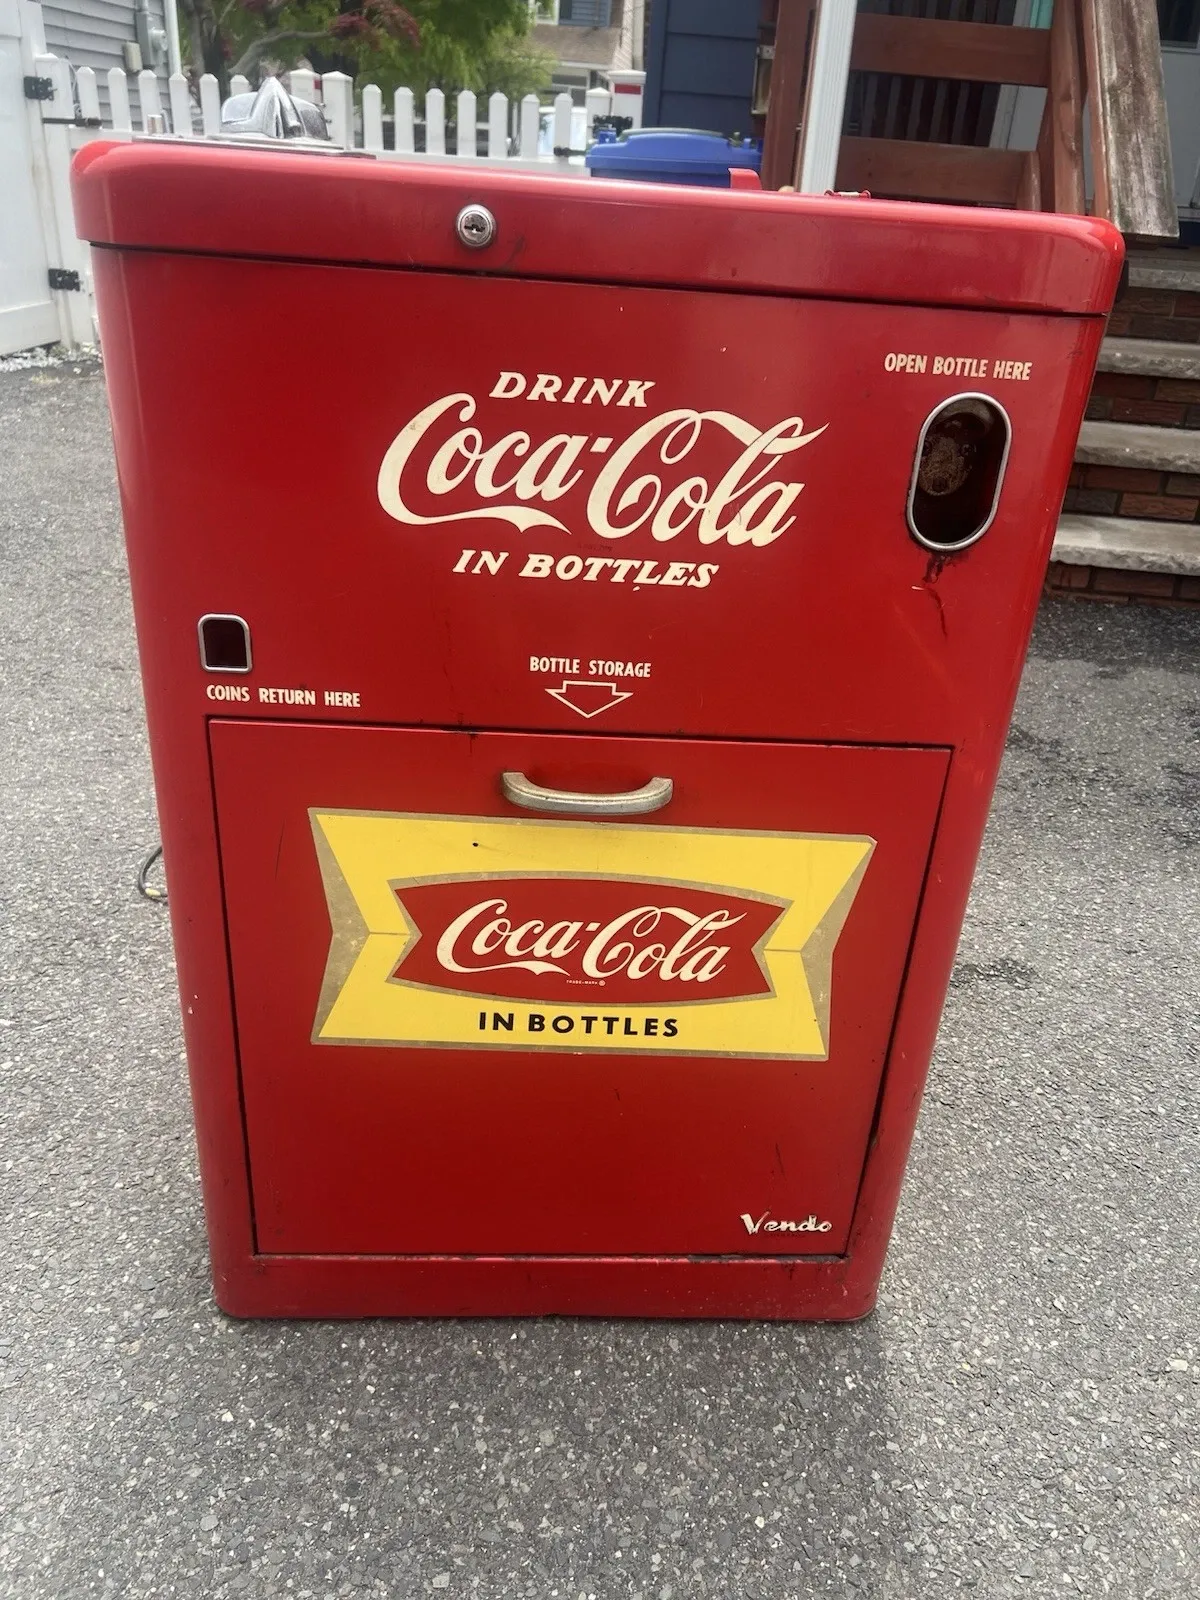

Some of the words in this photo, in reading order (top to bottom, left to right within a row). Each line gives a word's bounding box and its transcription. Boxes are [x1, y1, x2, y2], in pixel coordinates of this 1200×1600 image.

[884, 353, 927, 373] OPEN
[932, 356, 988, 378] BOTTLE
[993, 360, 1032, 380] HERE
[489, 371, 655, 408] DRINK
[377, 393, 830, 547] Coca-Cola
[453, 549, 510, 576] IN
[518, 554, 719, 589] BOTTLES
[529, 656, 580, 673] BOTTLE
[588, 660, 652, 678] STORAGE
[206, 684, 250, 702] COINS
[259, 688, 316, 705] RETURN
[324, 691, 361, 707] HERE
[436, 898, 747, 982] Coca-Cola
[479, 1012, 514, 1031] IN
[527, 1014, 679, 1037] BOTTLES
[740, 1211, 832, 1235] Vendo
